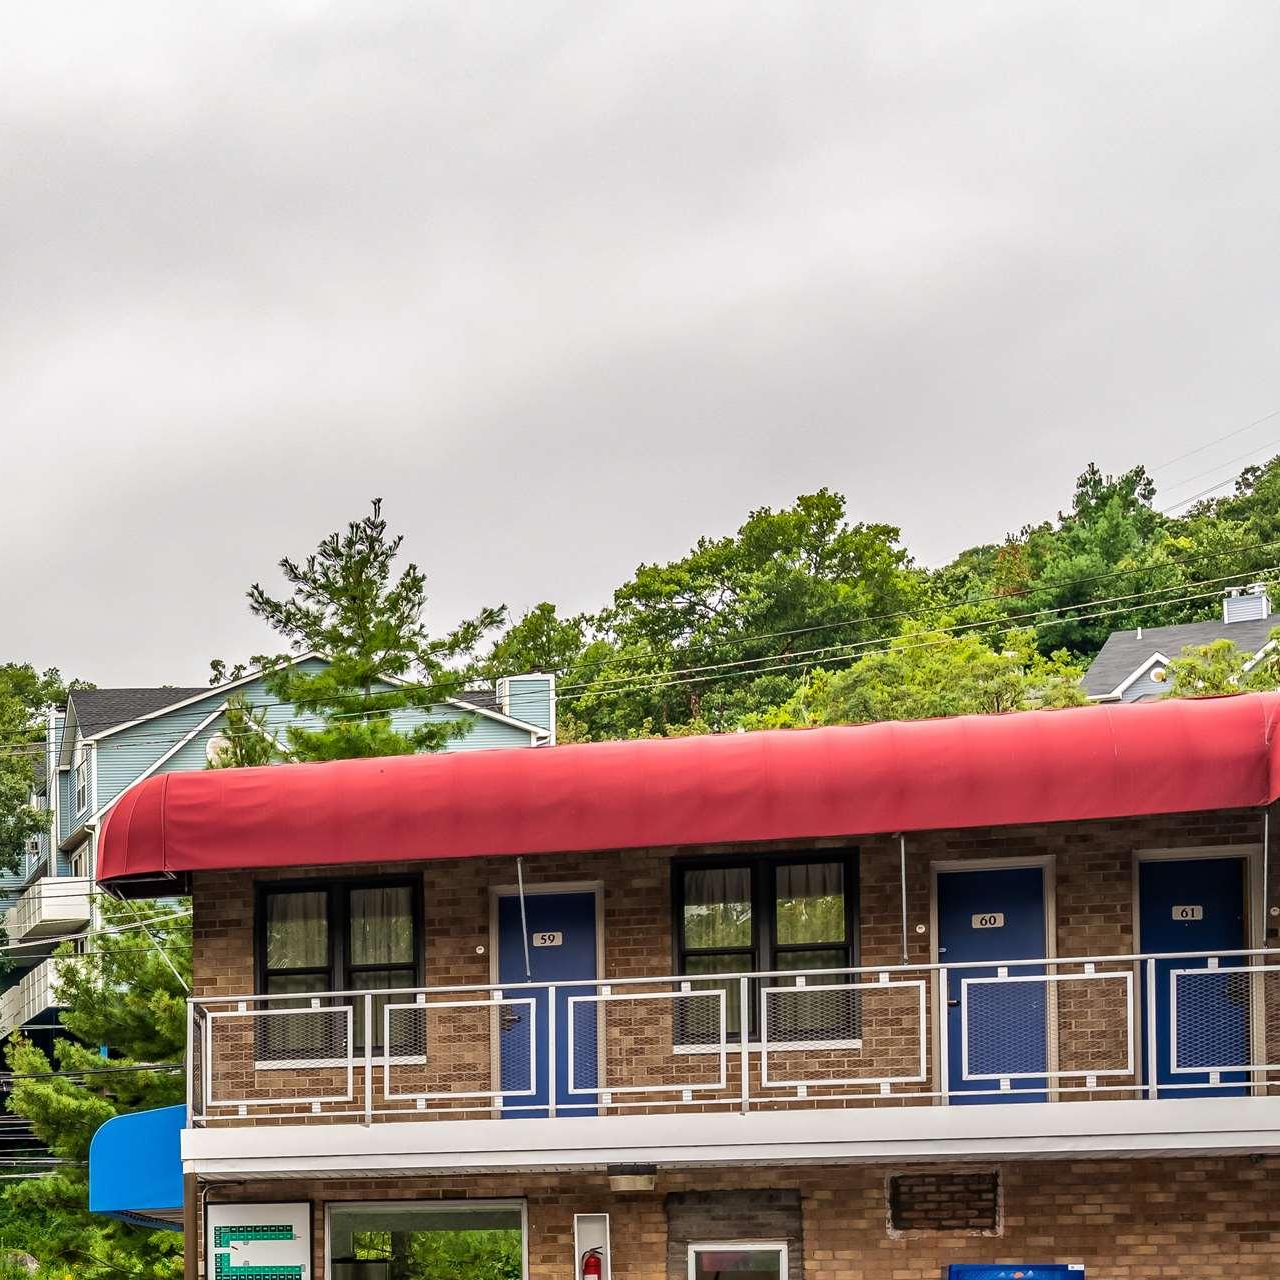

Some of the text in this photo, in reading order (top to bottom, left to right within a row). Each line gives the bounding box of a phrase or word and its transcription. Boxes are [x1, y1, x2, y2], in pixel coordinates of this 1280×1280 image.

[1180, 907, 1195, 919] 61
[979, 915, 997, 927] 60
[540, 933, 556, 945] 59
